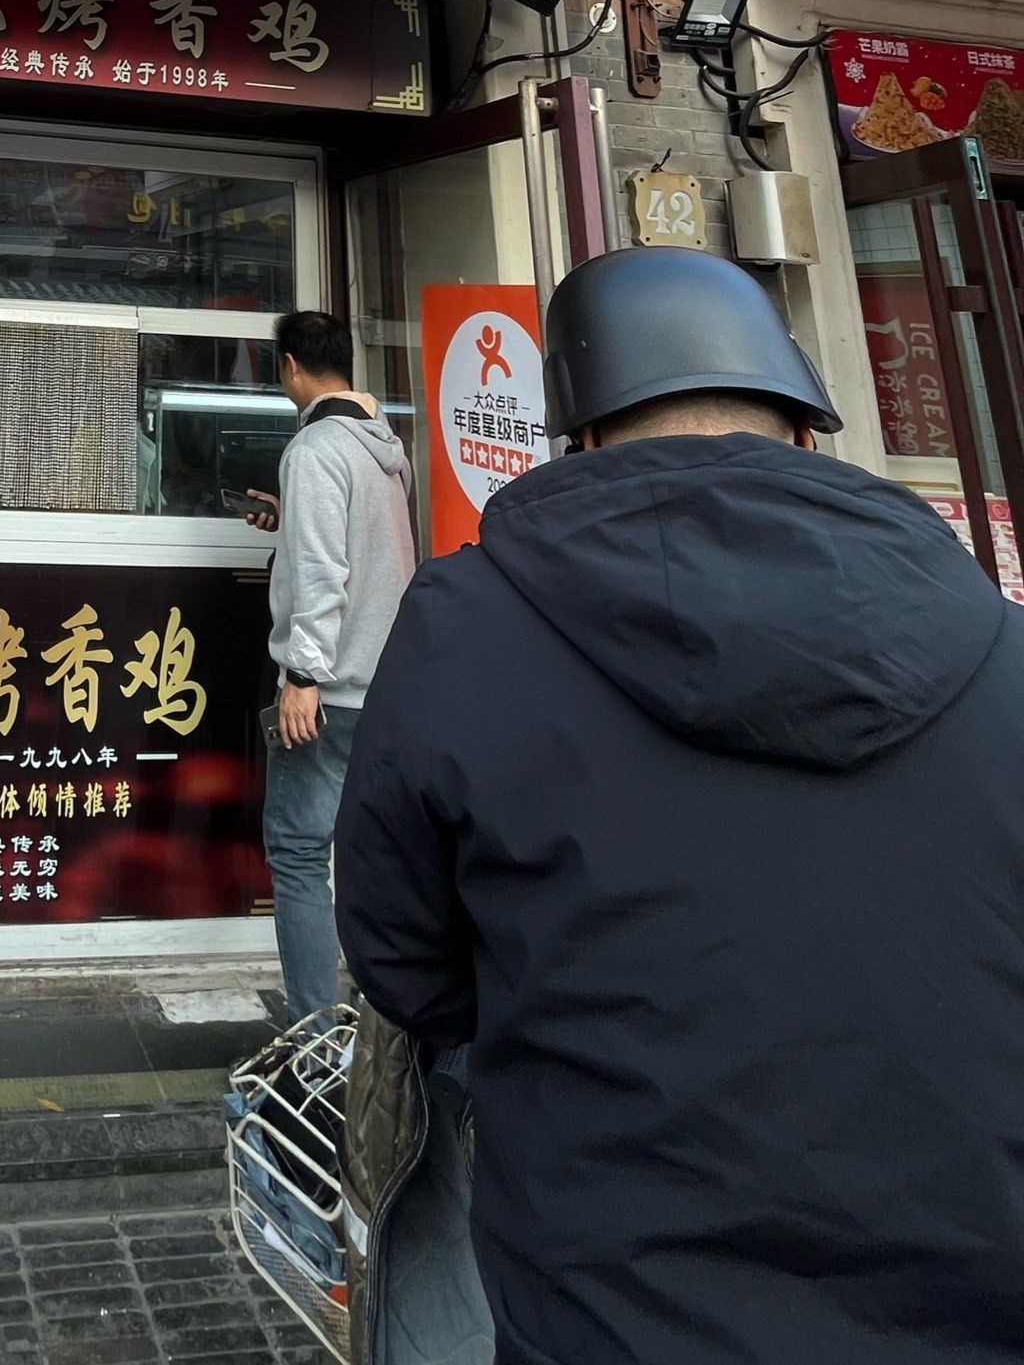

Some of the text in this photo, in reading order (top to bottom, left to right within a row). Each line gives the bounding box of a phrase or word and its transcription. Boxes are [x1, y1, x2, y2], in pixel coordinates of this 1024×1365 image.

[0, 47, 94, 79] 经典传承
[112, 58, 229, 92] 始于1998年
[645, 189, 695, 236] 42
[474, 391, 519, 416] 大众点评
[453, 407, 546, 447] 年度星级商户
